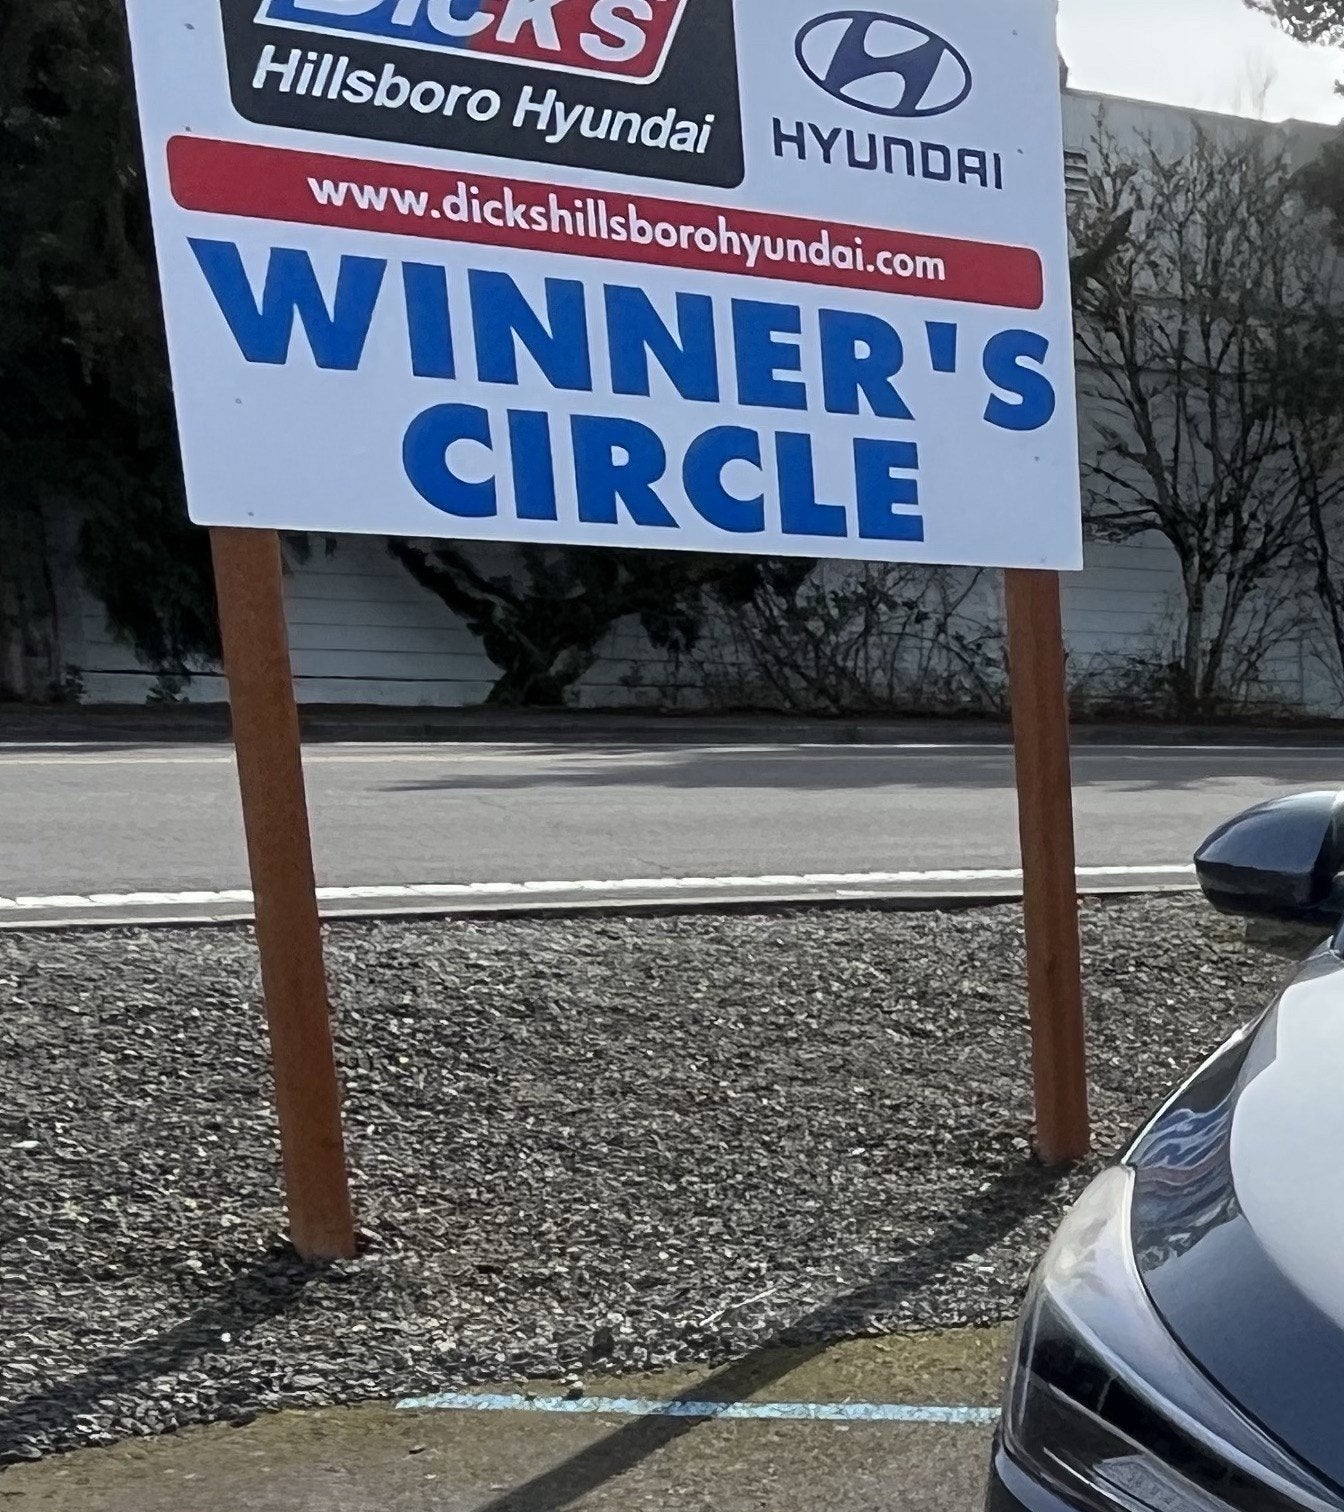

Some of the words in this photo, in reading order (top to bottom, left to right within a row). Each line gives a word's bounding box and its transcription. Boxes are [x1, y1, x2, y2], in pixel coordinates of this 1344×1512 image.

[252, 44, 501, 120] Hillsboro
[512, 85, 715, 153] Hyundai
[772, 116, 1002, 190] HYUNDAI
[306, 177, 946, 282] www.dickshillsborohyundai.com
[187, 237, 1056, 431] WINNER'S
[402, 402, 925, 543] CIRCLE
